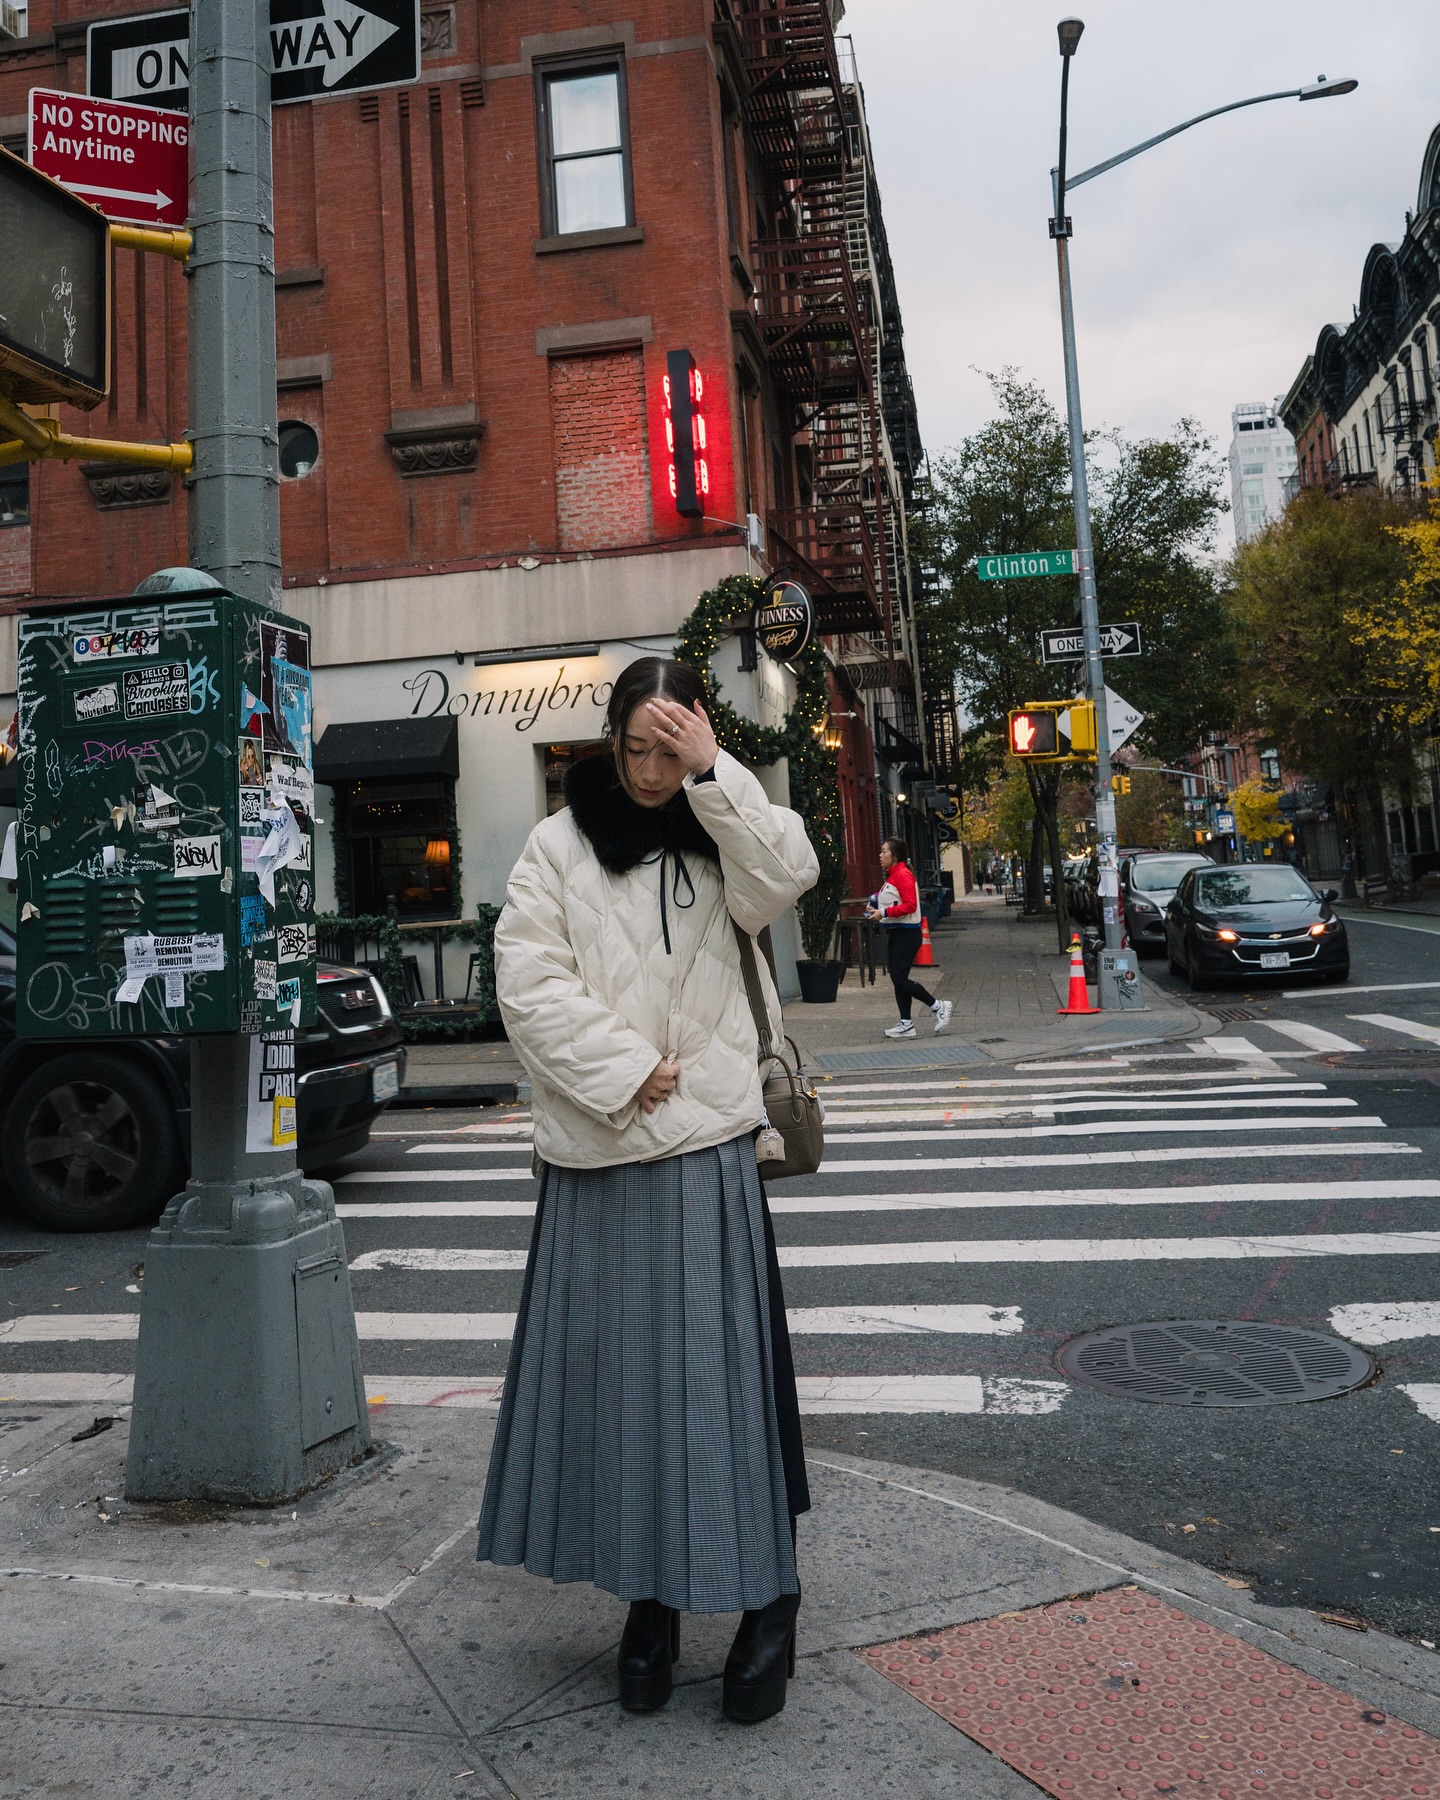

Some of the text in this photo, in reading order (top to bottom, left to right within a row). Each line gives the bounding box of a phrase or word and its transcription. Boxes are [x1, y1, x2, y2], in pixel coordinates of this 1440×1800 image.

[136, 15, 366, 90] ON WAY
[42, 103, 188, 146] NO STOPPING
[42, 130, 136, 164] Anytime
[986, 554, 1067, 577] Clinton St
[1057, 637, 1084, 651] ONE
[141, 667, 170, 680] HELLO
[126, 681, 188, 702] Brooklyn
[402, 664, 614, 732] Donnybro
[153, 936, 193, 947] RUBBISH
[155, 945, 193, 956] REMOVAL
[157, 956, 193, 967] DEMOLITION
